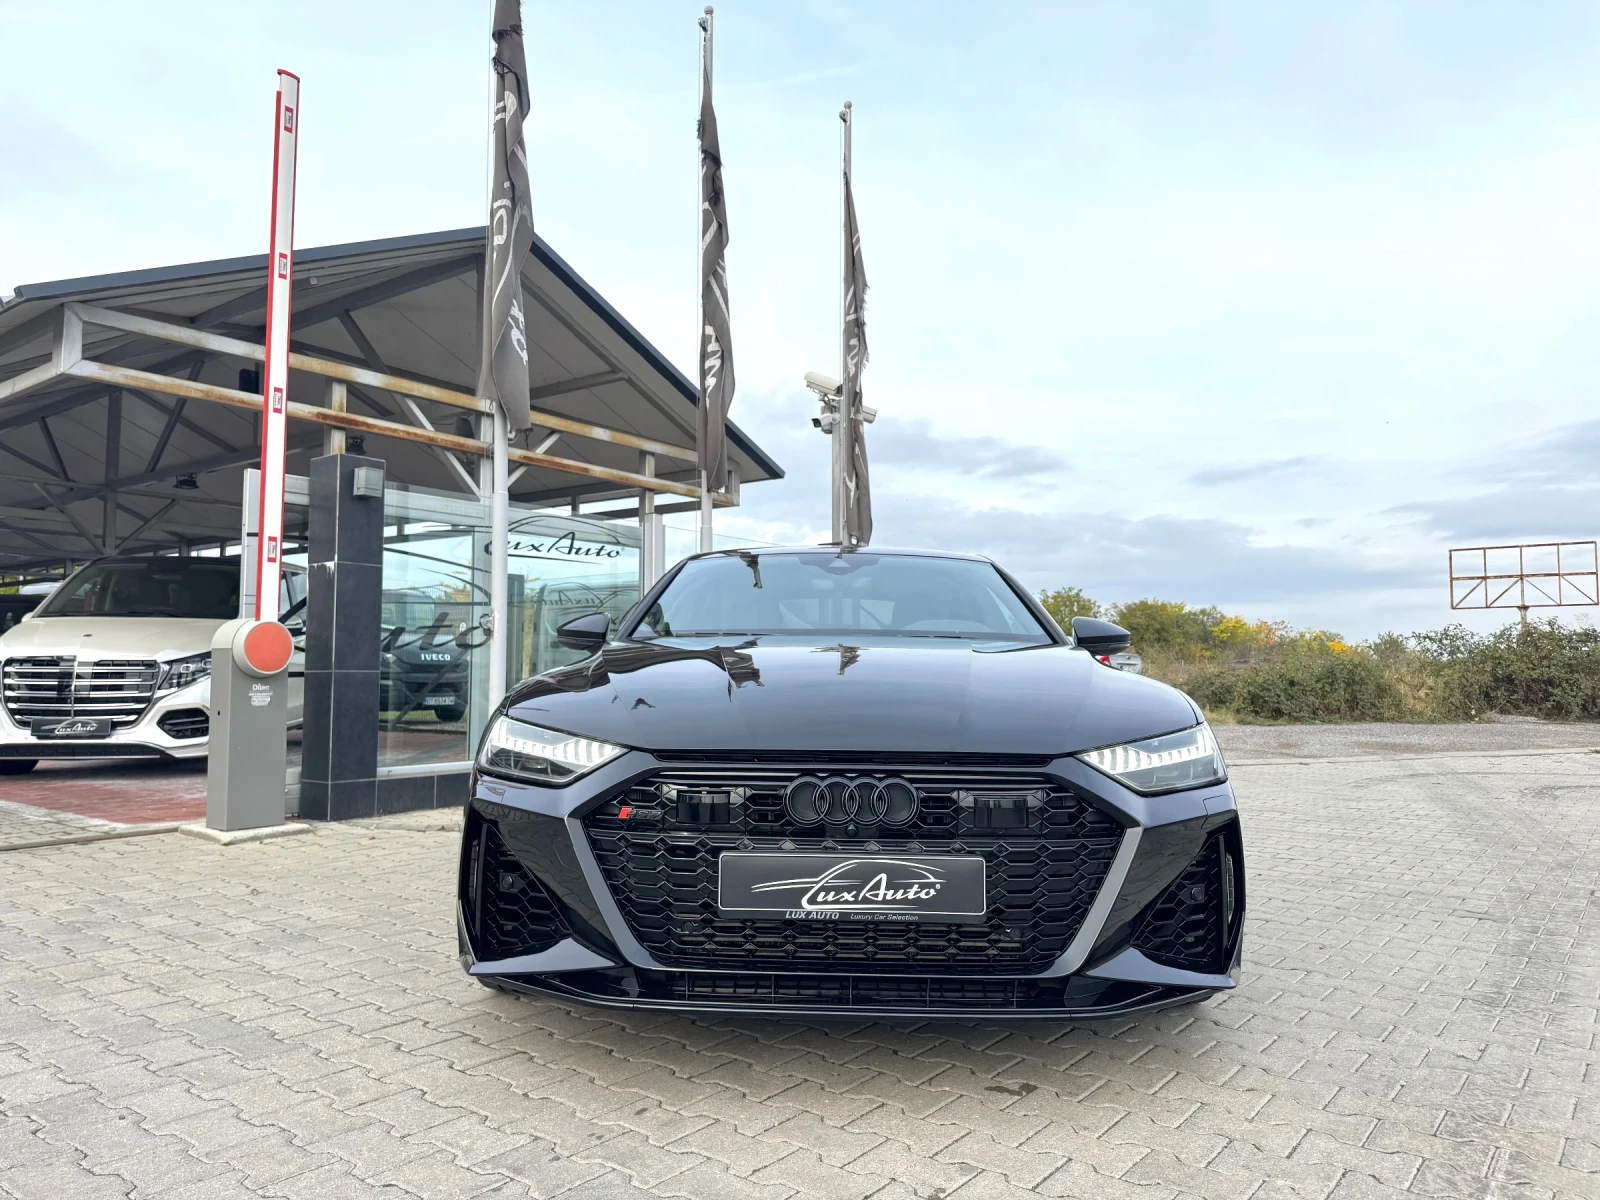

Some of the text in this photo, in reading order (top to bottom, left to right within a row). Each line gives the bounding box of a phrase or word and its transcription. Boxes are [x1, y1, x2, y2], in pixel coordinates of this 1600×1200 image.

[547, 531, 622, 558] Auto
[421, 653, 451, 661] IVECO
[801, 873, 937, 909] Lux Auto
[785, 910, 808, 919] LUX
[809, 911, 840, 920] AUTO
[850, 913, 873, 921] Luxury
